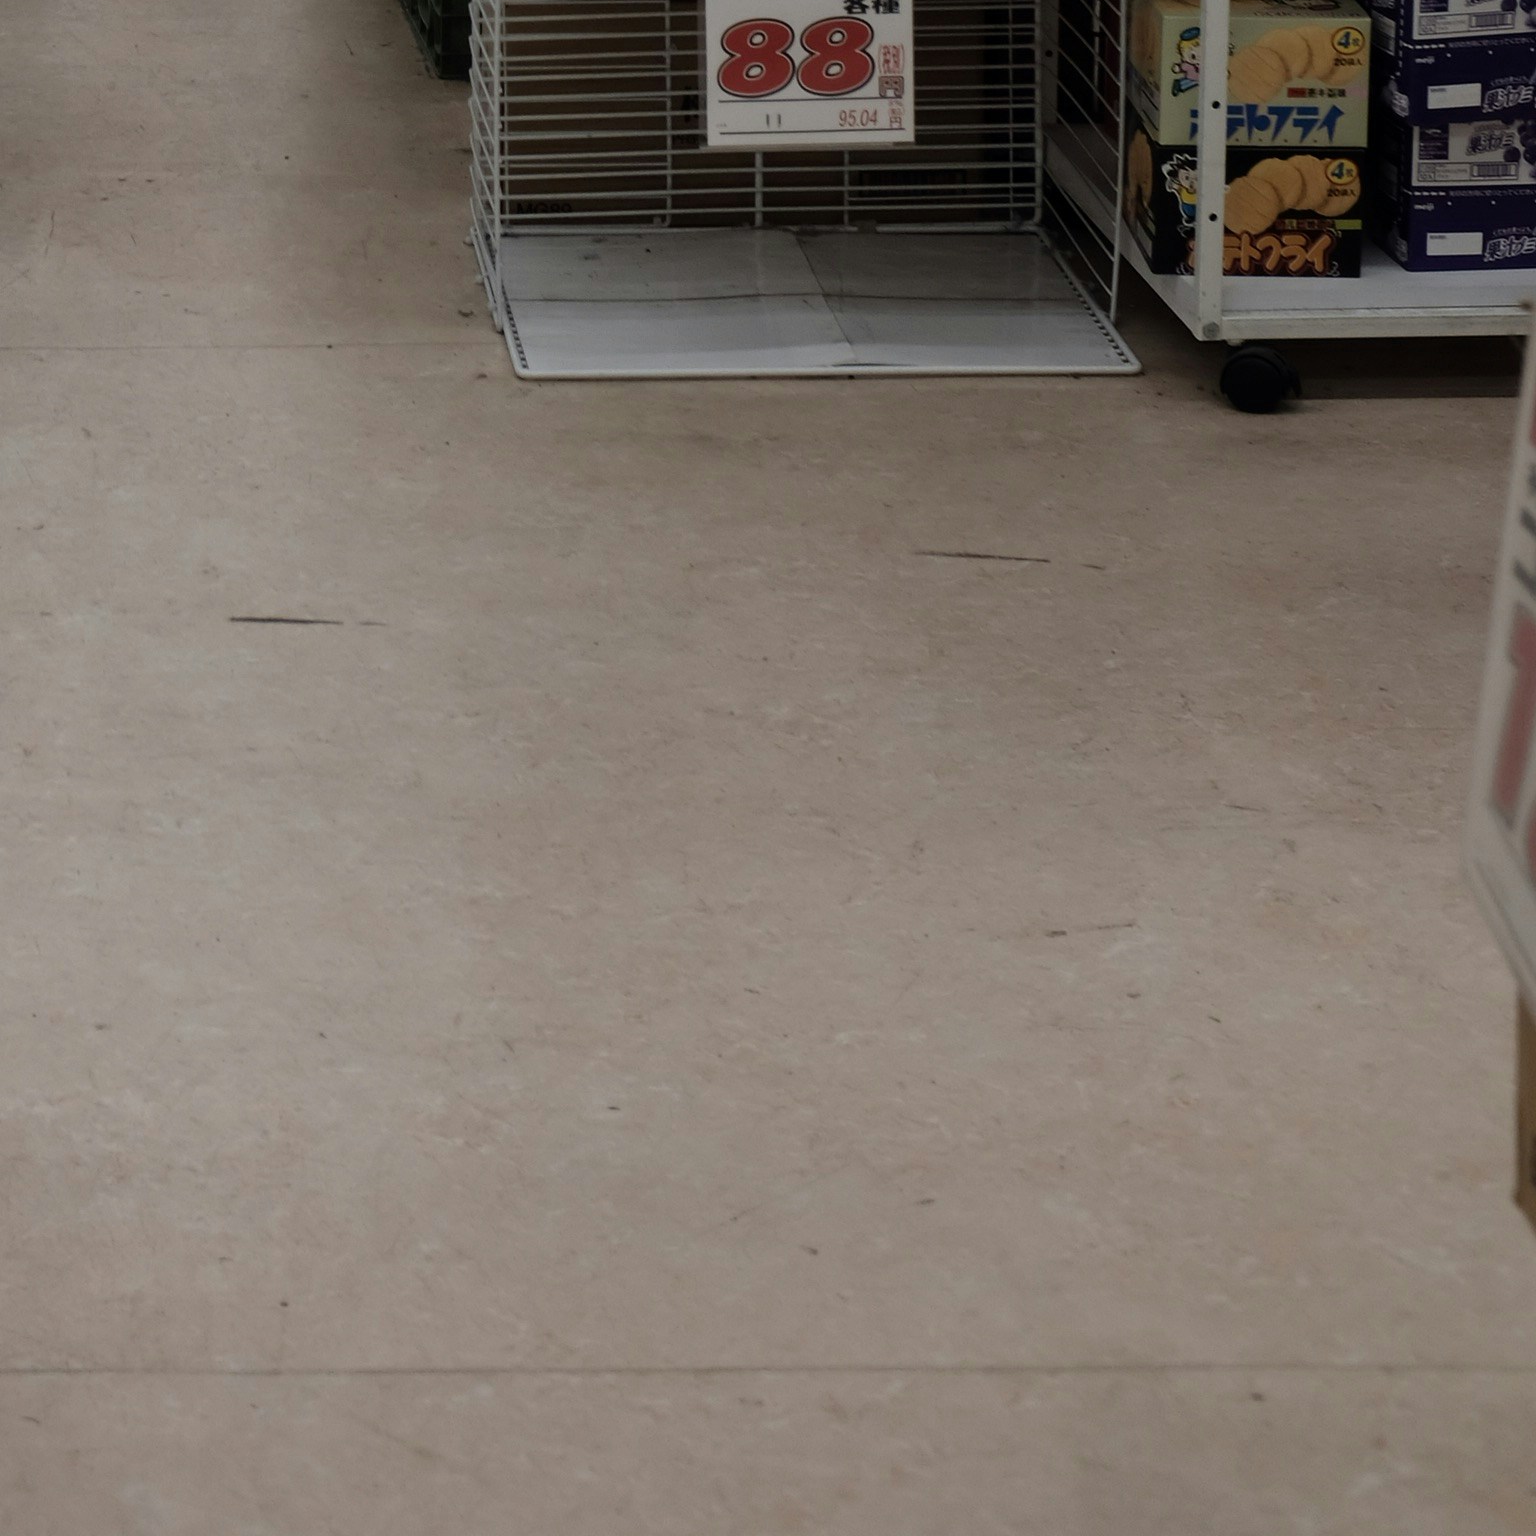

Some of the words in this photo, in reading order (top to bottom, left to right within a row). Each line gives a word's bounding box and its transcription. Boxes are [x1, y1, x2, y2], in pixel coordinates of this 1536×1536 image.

[717, 16, 875, 99] 88
[838, 109, 879, 128] 95.04
[1188, 104, 1346, 144] テトフライ
[1187, 232, 1337, 274] テトフライ
